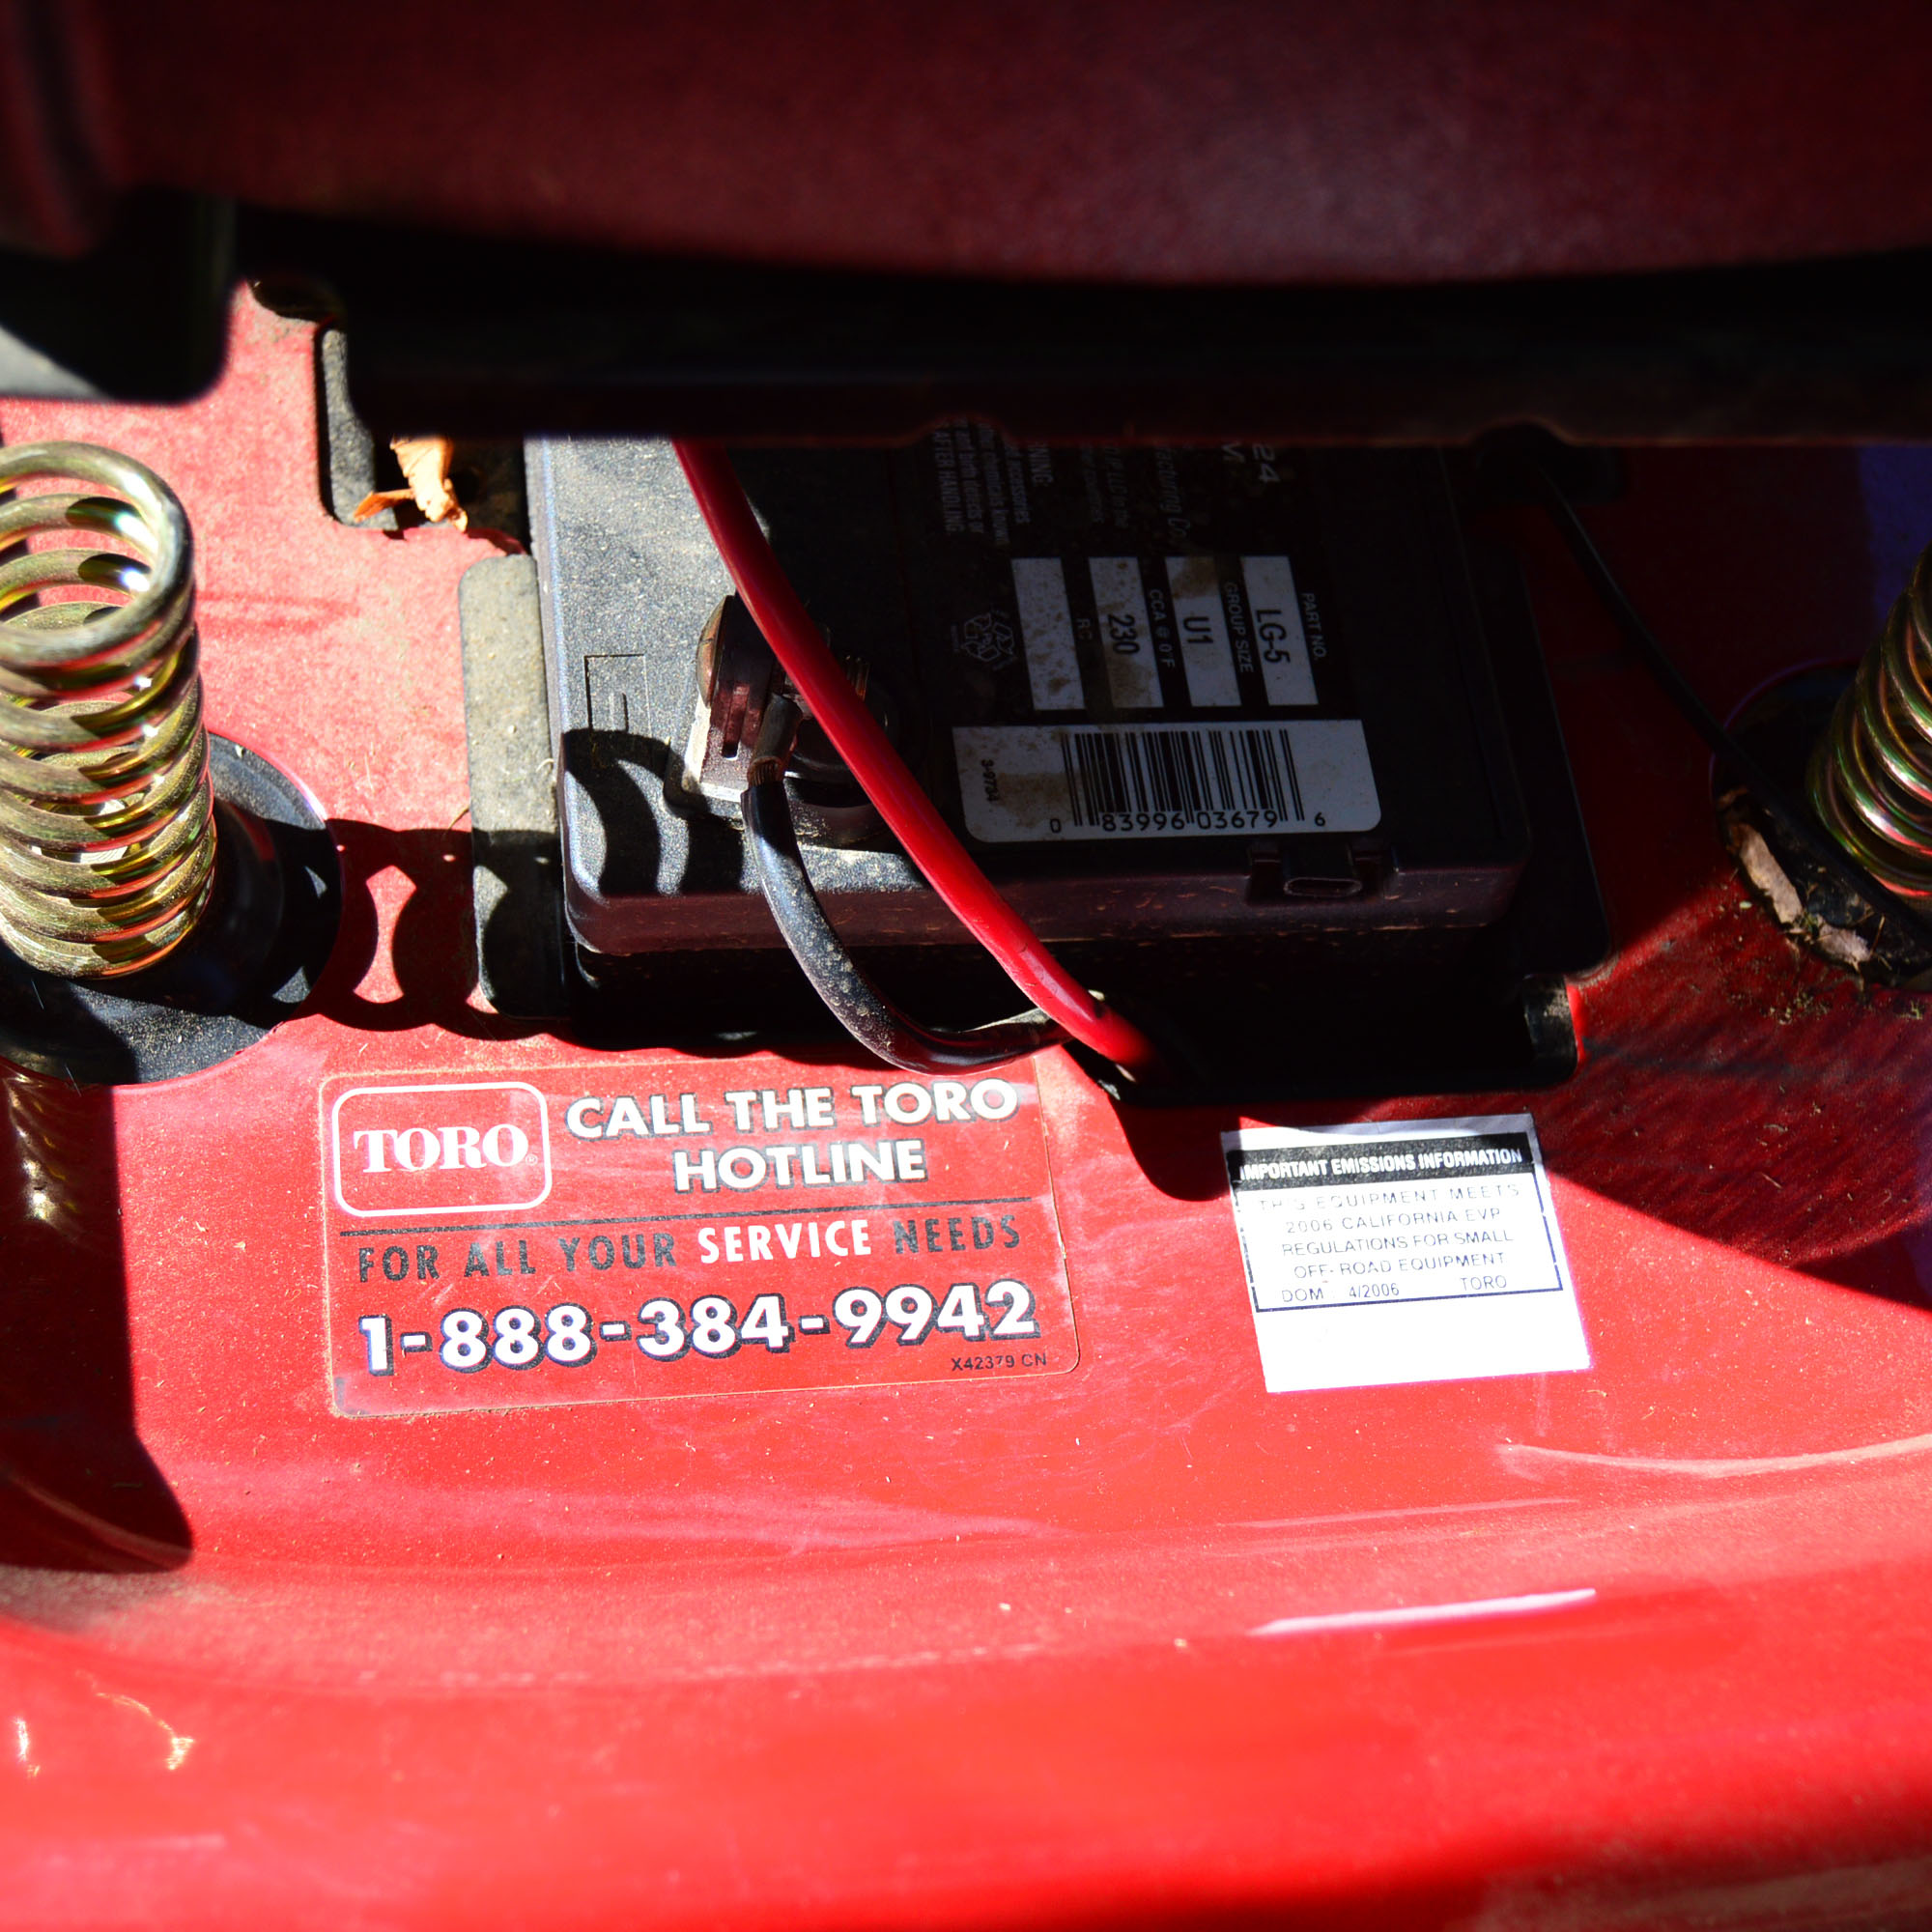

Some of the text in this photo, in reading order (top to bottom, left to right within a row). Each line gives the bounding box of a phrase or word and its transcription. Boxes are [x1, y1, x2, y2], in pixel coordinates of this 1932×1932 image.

[932, 431, 956, 469] AFTER
[1027, 441, 1054, 487] NING:
[981, 450, 1006, 507] chemicals
[1007, 458, 1031, 525] accessories
[1154, 445, 1183, 514] facturing
[991, 509, 1011, 545] known
[1149, 587, 1166, 623] CCA
[1300, 592, 1327, 661] PART NO.
[1076, 617, 1093, 640] RC
[1108, 612, 1140, 655] 230
[1182, 615, 1214, 645] U1
[1222, 581, 1254, 673] GROUP SIZE
[1255, 608, 1291, 665] LG-5
[980, 759, 996, 803] 3-9734
[1049, 810, 1326, 832] 0 83996 03679 6
[565, 1077, 1021, 1142] CALL THE TORO
[354, 1122, 529, 1174] TORO
[672, 1138, 928, 1195] HOTLINE
[1239, 1148, 1522, 1180] IMPORTANT EMISSIONS INFORMATION
[1259, 1181, 1520, 1212] THS EQUIPMENT MEETS
[1286, 1207, 1500, 1235] 2006 CALIFORNIA EVP
[357, 1213, 1021, 1283] FOR ALL YOUR SERVICE NEEDS
[1282, 1230, 1514, 1257] REGULATIONS FOR SMALL
[1294, 1252, 1504, 1279] OFF- ROAD EQUIPMENT
[1282, 1275, 1508, 1303] DOM 4/2006 TORO
[358, 1278, 1040, 1378] 1-888-384-9942
[951, 1352, 1047, 1373] X42379 CN
